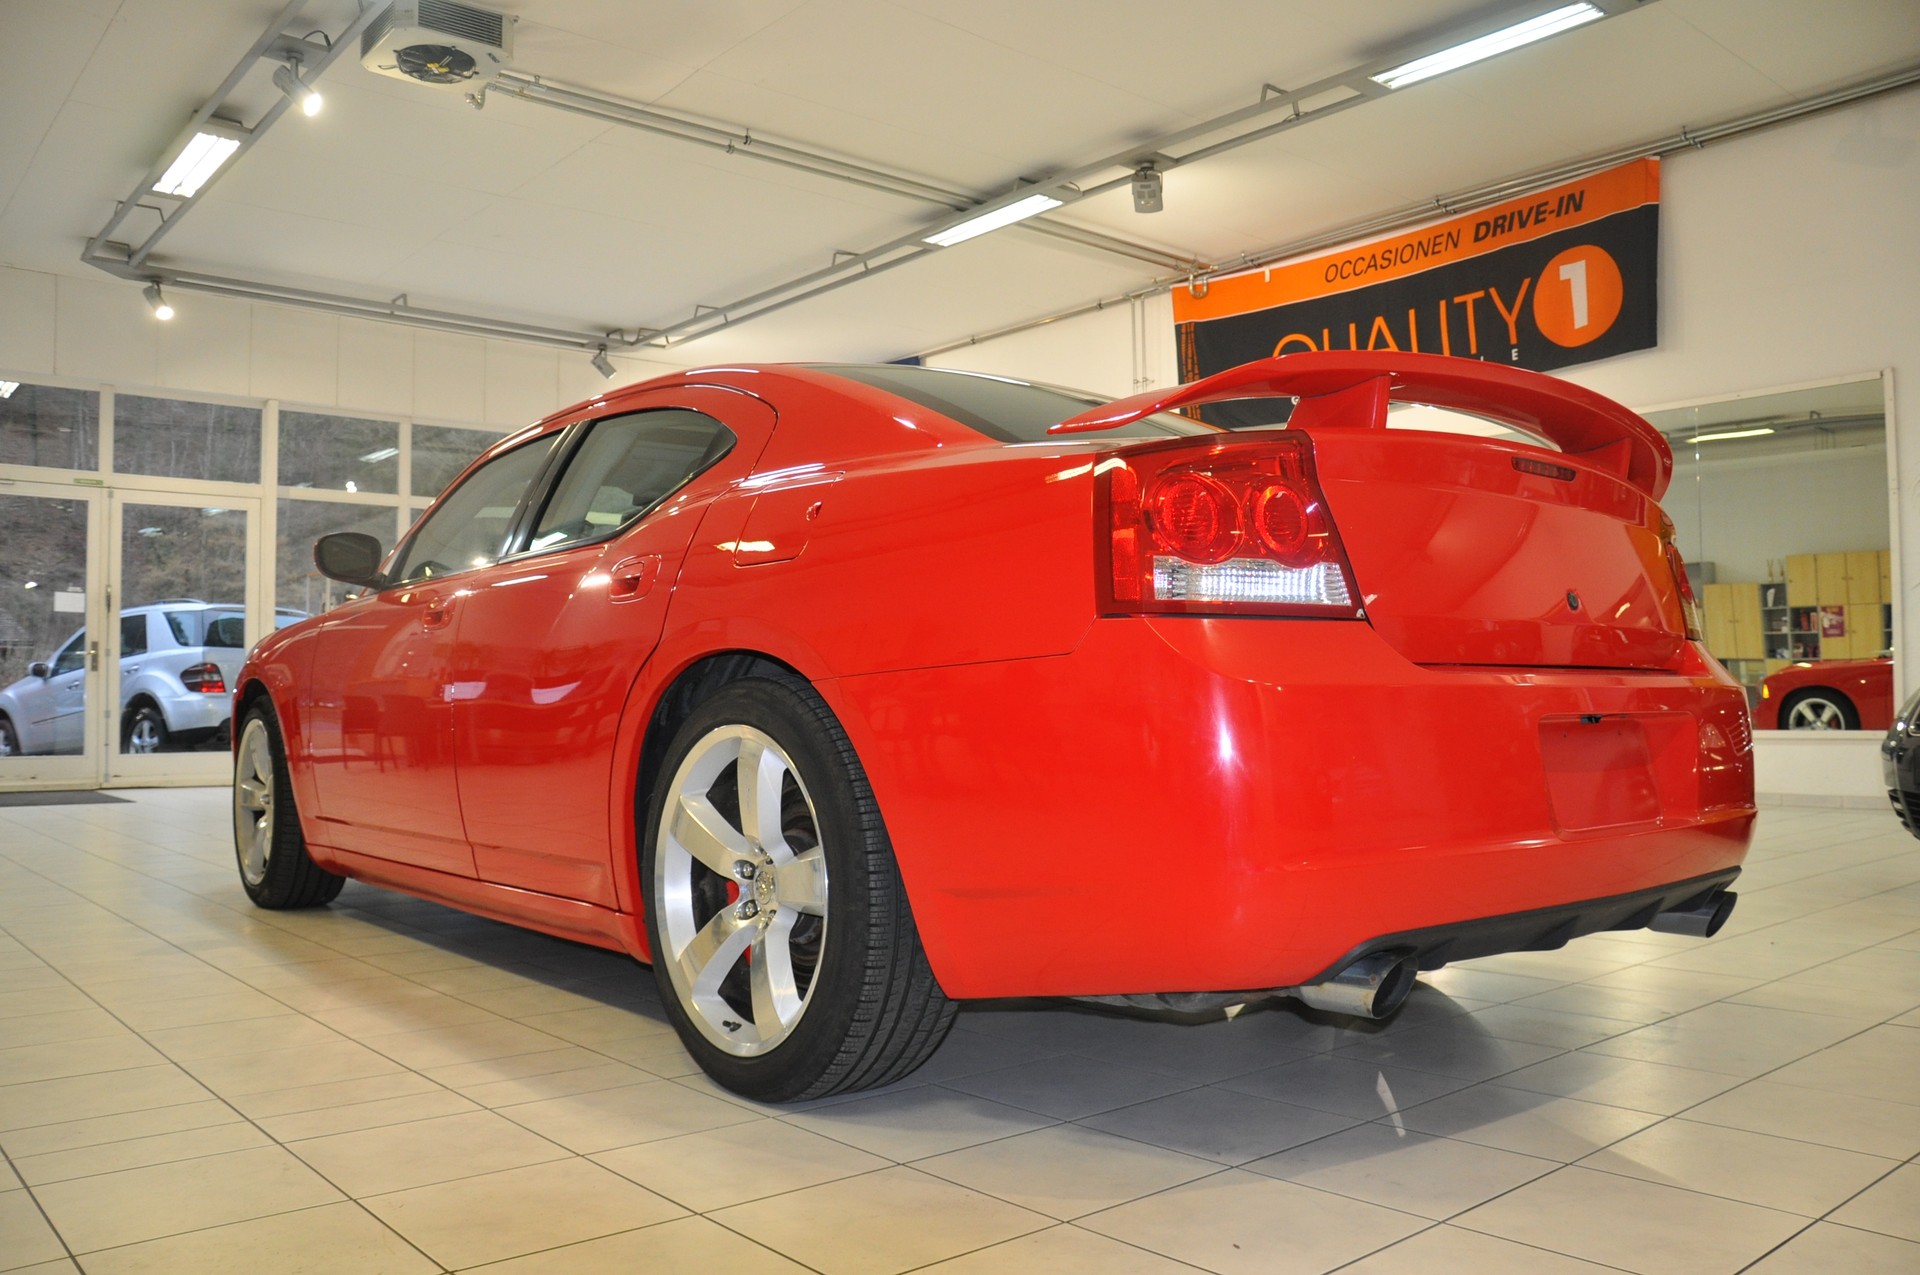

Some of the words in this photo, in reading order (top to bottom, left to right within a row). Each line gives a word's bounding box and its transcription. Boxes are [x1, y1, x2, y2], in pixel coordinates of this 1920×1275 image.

[1324, 228, 1461, 283] OCCASIONEN
[1473, 189, 1585, 244] DRIVE-IN
[1559, 259, 1589, 330] 1
